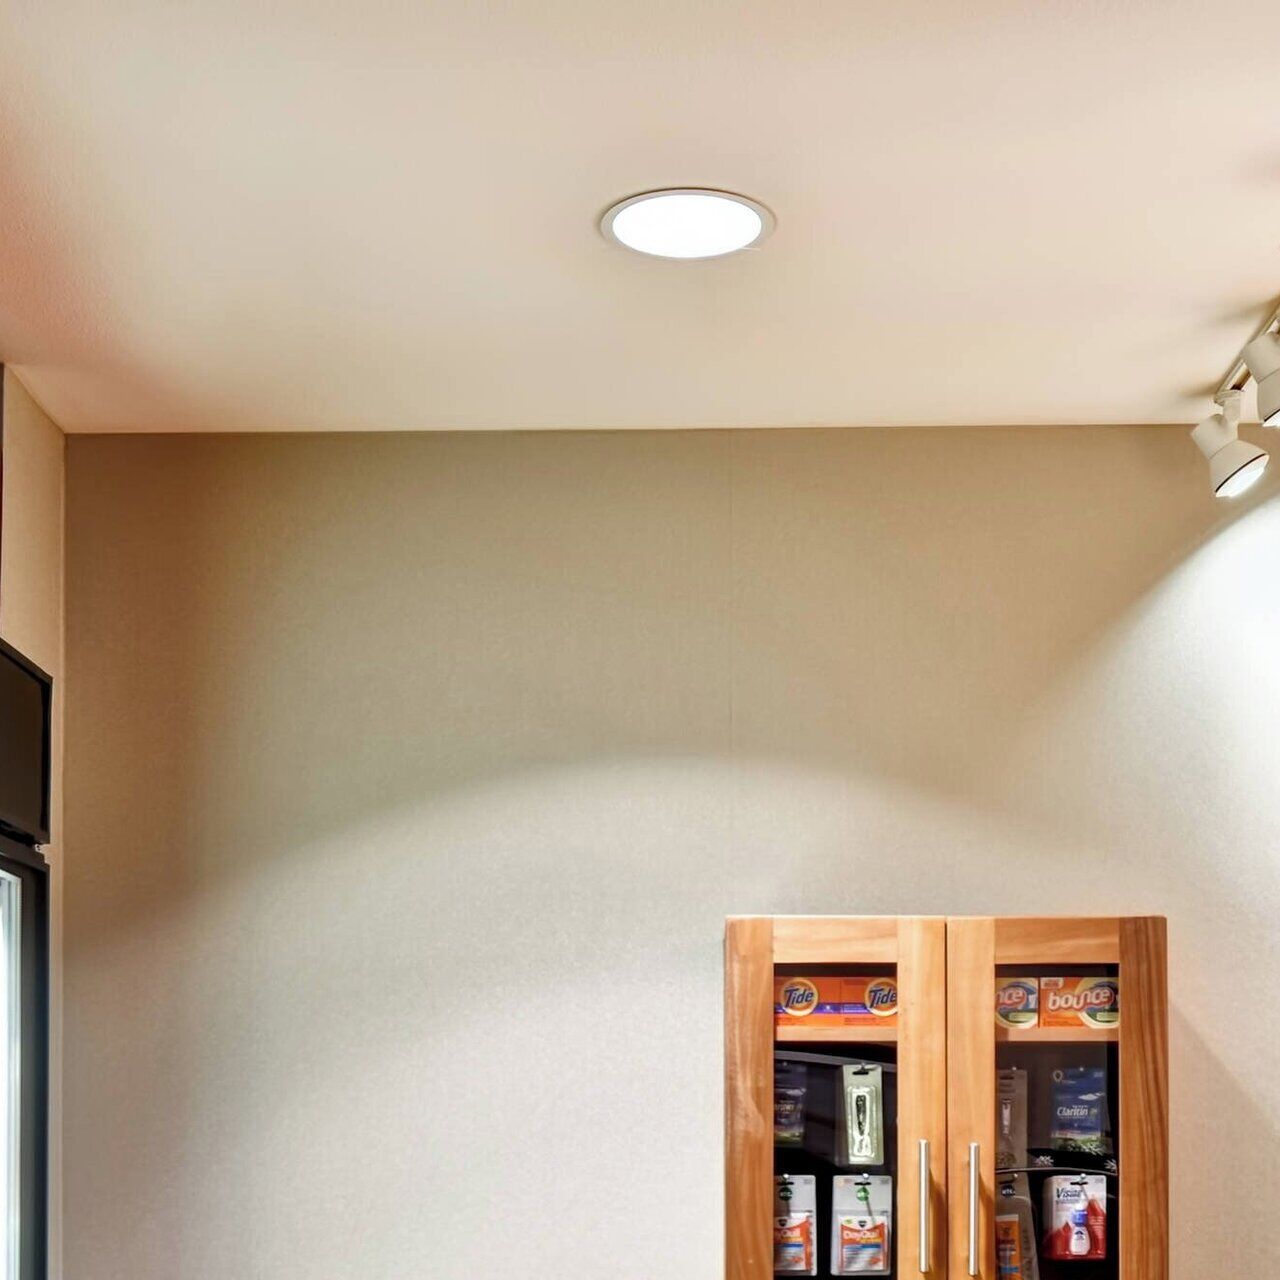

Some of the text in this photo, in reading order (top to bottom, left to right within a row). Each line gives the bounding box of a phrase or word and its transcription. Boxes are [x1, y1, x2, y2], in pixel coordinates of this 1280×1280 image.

[783, 986, 815, 1008] Tide
[1048, 988, 1112, 1012] bounce
[1057, 1105, 1088, 1117] Claritin
